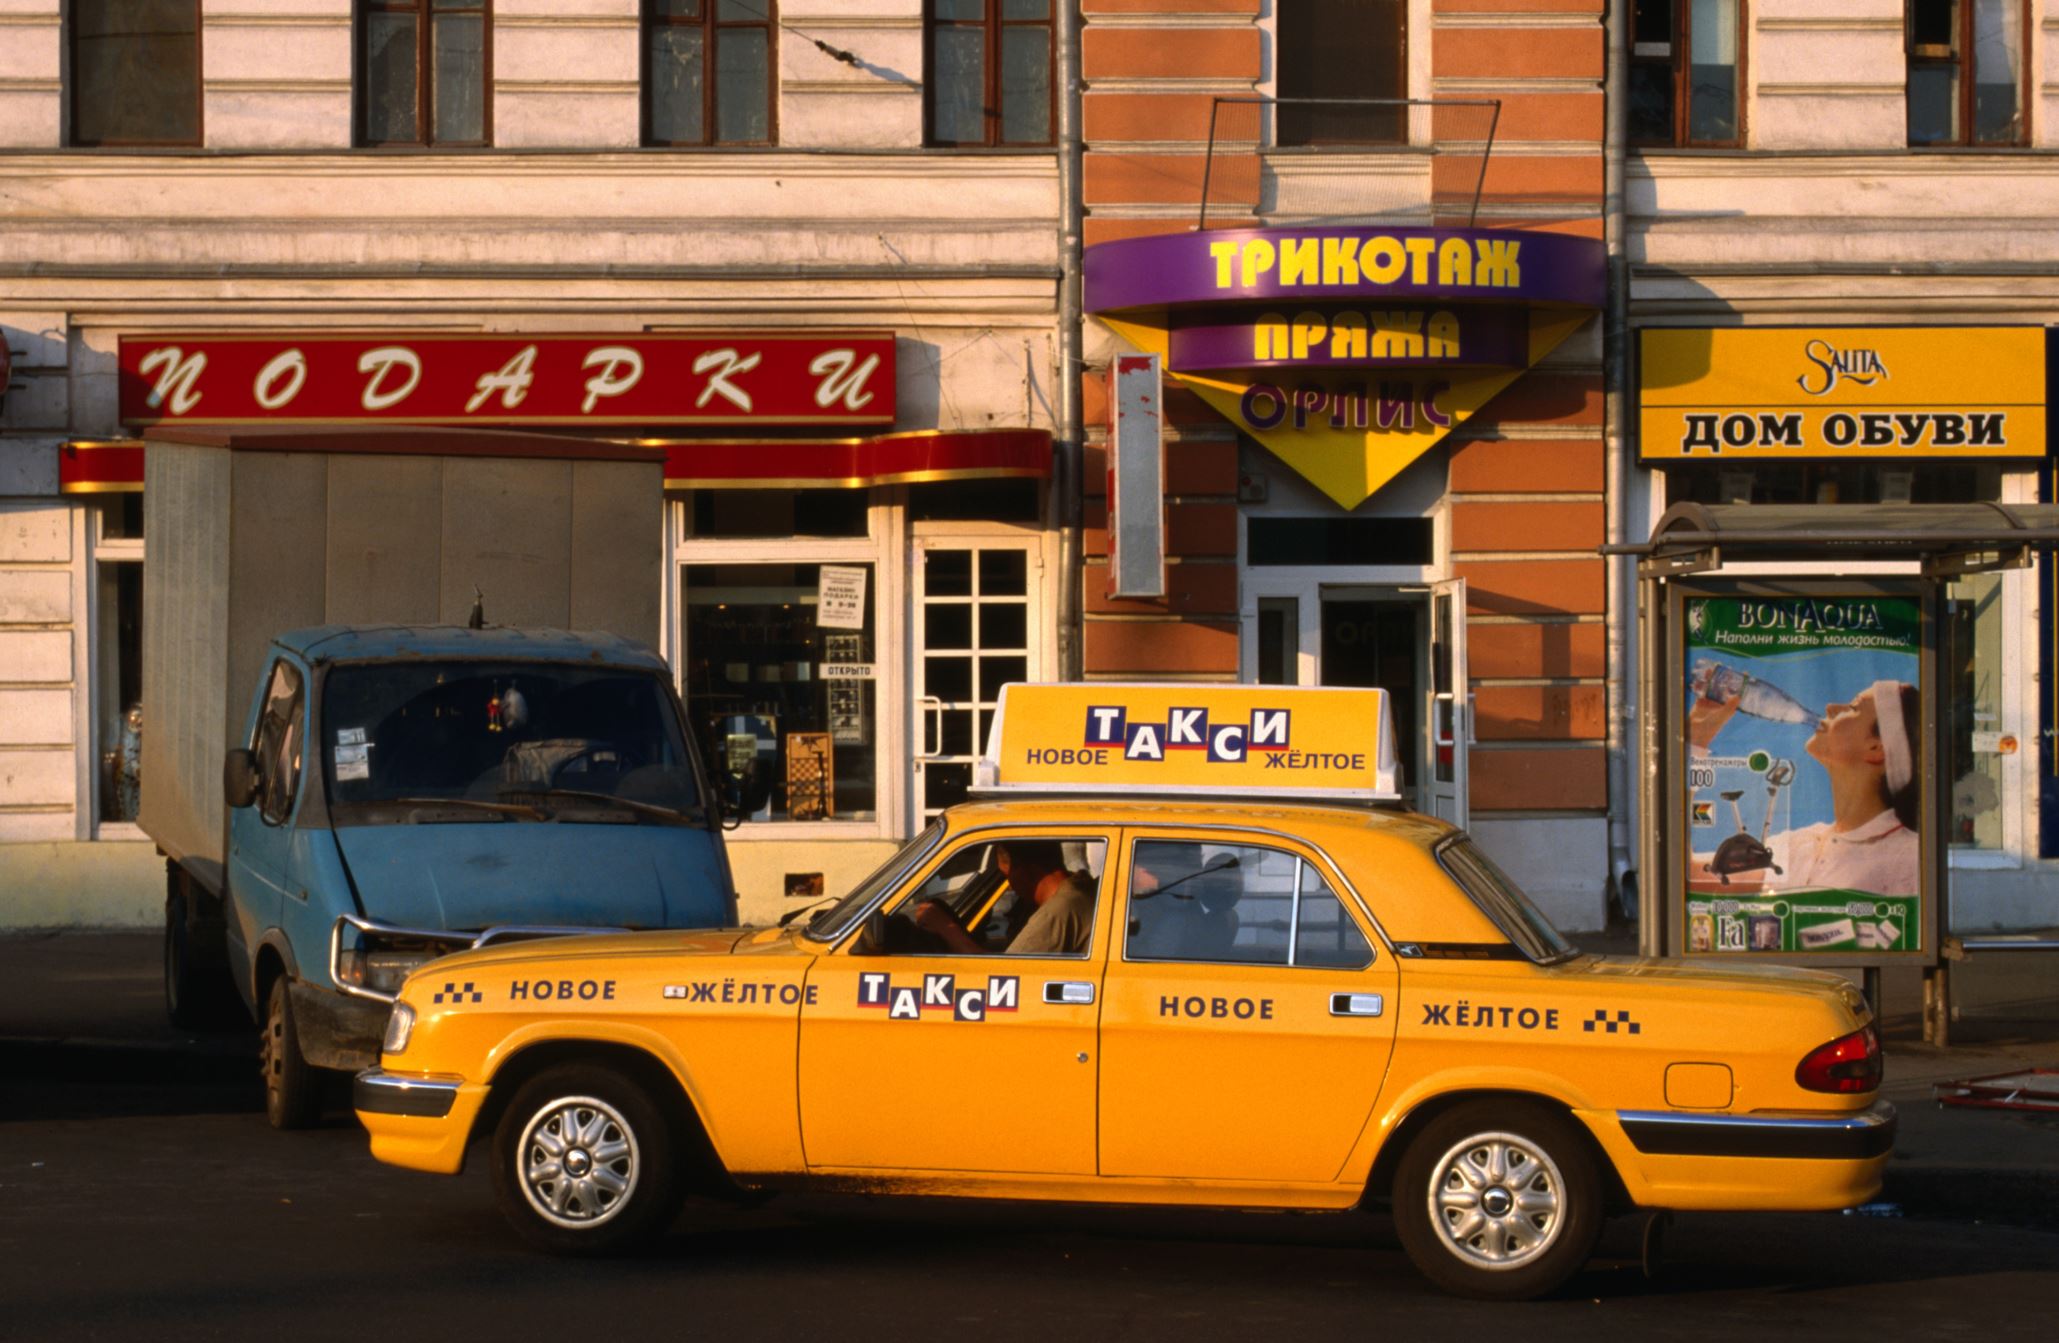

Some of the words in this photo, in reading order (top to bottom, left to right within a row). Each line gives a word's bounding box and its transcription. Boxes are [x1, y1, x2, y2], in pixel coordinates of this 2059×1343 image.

[1209, 236, 1521, 289] ТРИКОТАЖ
[1253, 311, 1461, 360] ПРЯЖА
[1239, 382, 1452, 431] ОРЛИС
[1681, 413, 1803, 454] ДОМ
[1821, 412, 2007, 447] ОБУВИ
[1714, 630, 1774, 645] Наполни
[1777, 634, 1820, 646] жизнь
[1822, 633, 1911, 649] молодостью!
[828, 666, 871, 675] ОТКРЫТО
[1092, 707, 1288, 761] ТАКСИ
[1026, 748, 1109, 766] НОВОЕ
[1264, 750, 1366, 770] ЖЁЛТОЕ
[1690, 769, 1713, 787] 100
[510, 980, 616, 1000] НОВОЕ
[689, 978, 818, 1005] ЖЁЛТОЕ
[864, 974, 1018, 1020] ТАКСИ
[1159, 995, 1273, 1020] НОВОЕ
[1421, 1000, 1559, 1030] ЖЁЛТОЕ
